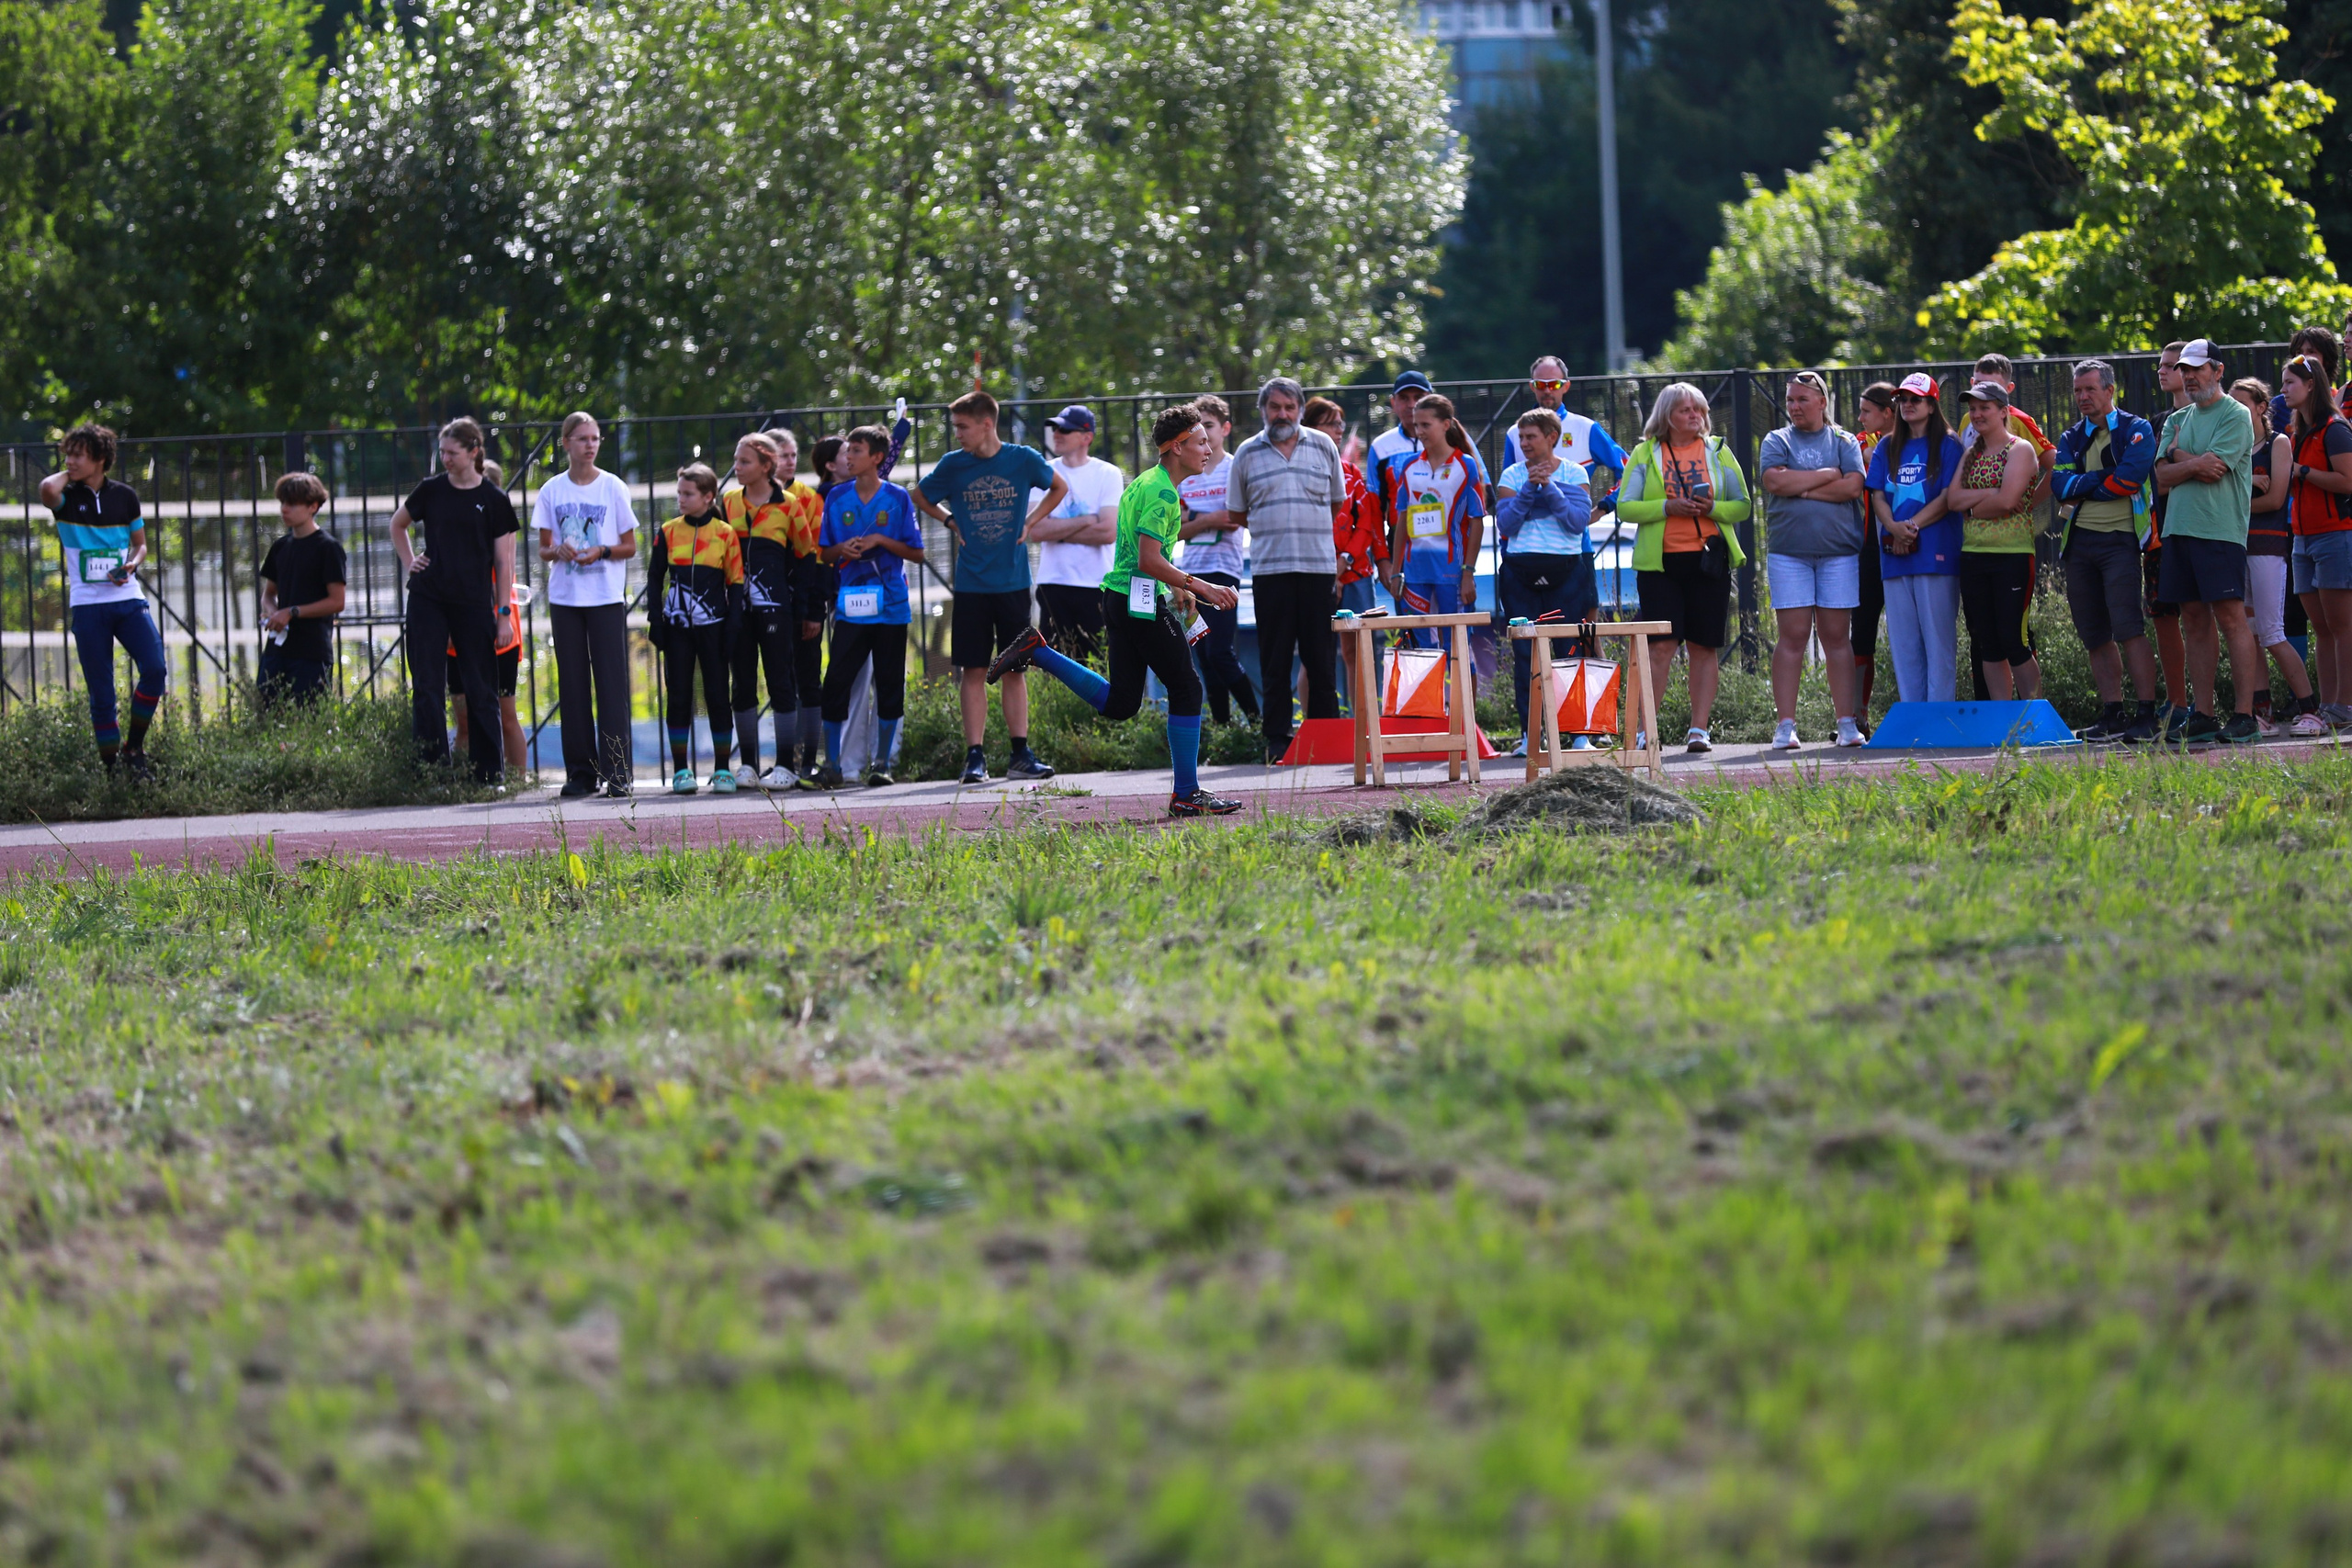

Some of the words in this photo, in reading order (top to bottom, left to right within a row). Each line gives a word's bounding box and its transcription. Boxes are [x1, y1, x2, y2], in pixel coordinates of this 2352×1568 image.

[1897, 466, 1922, 475] SPORTY
[962, 491, 988, 502] FREE
[992, 487, 1018, 500] SOUL
[1417, 515, 1434, 525] 220.1
[1142, 584, 1150, 604] 103.3
[850, 599, 870, 607] 311.3
